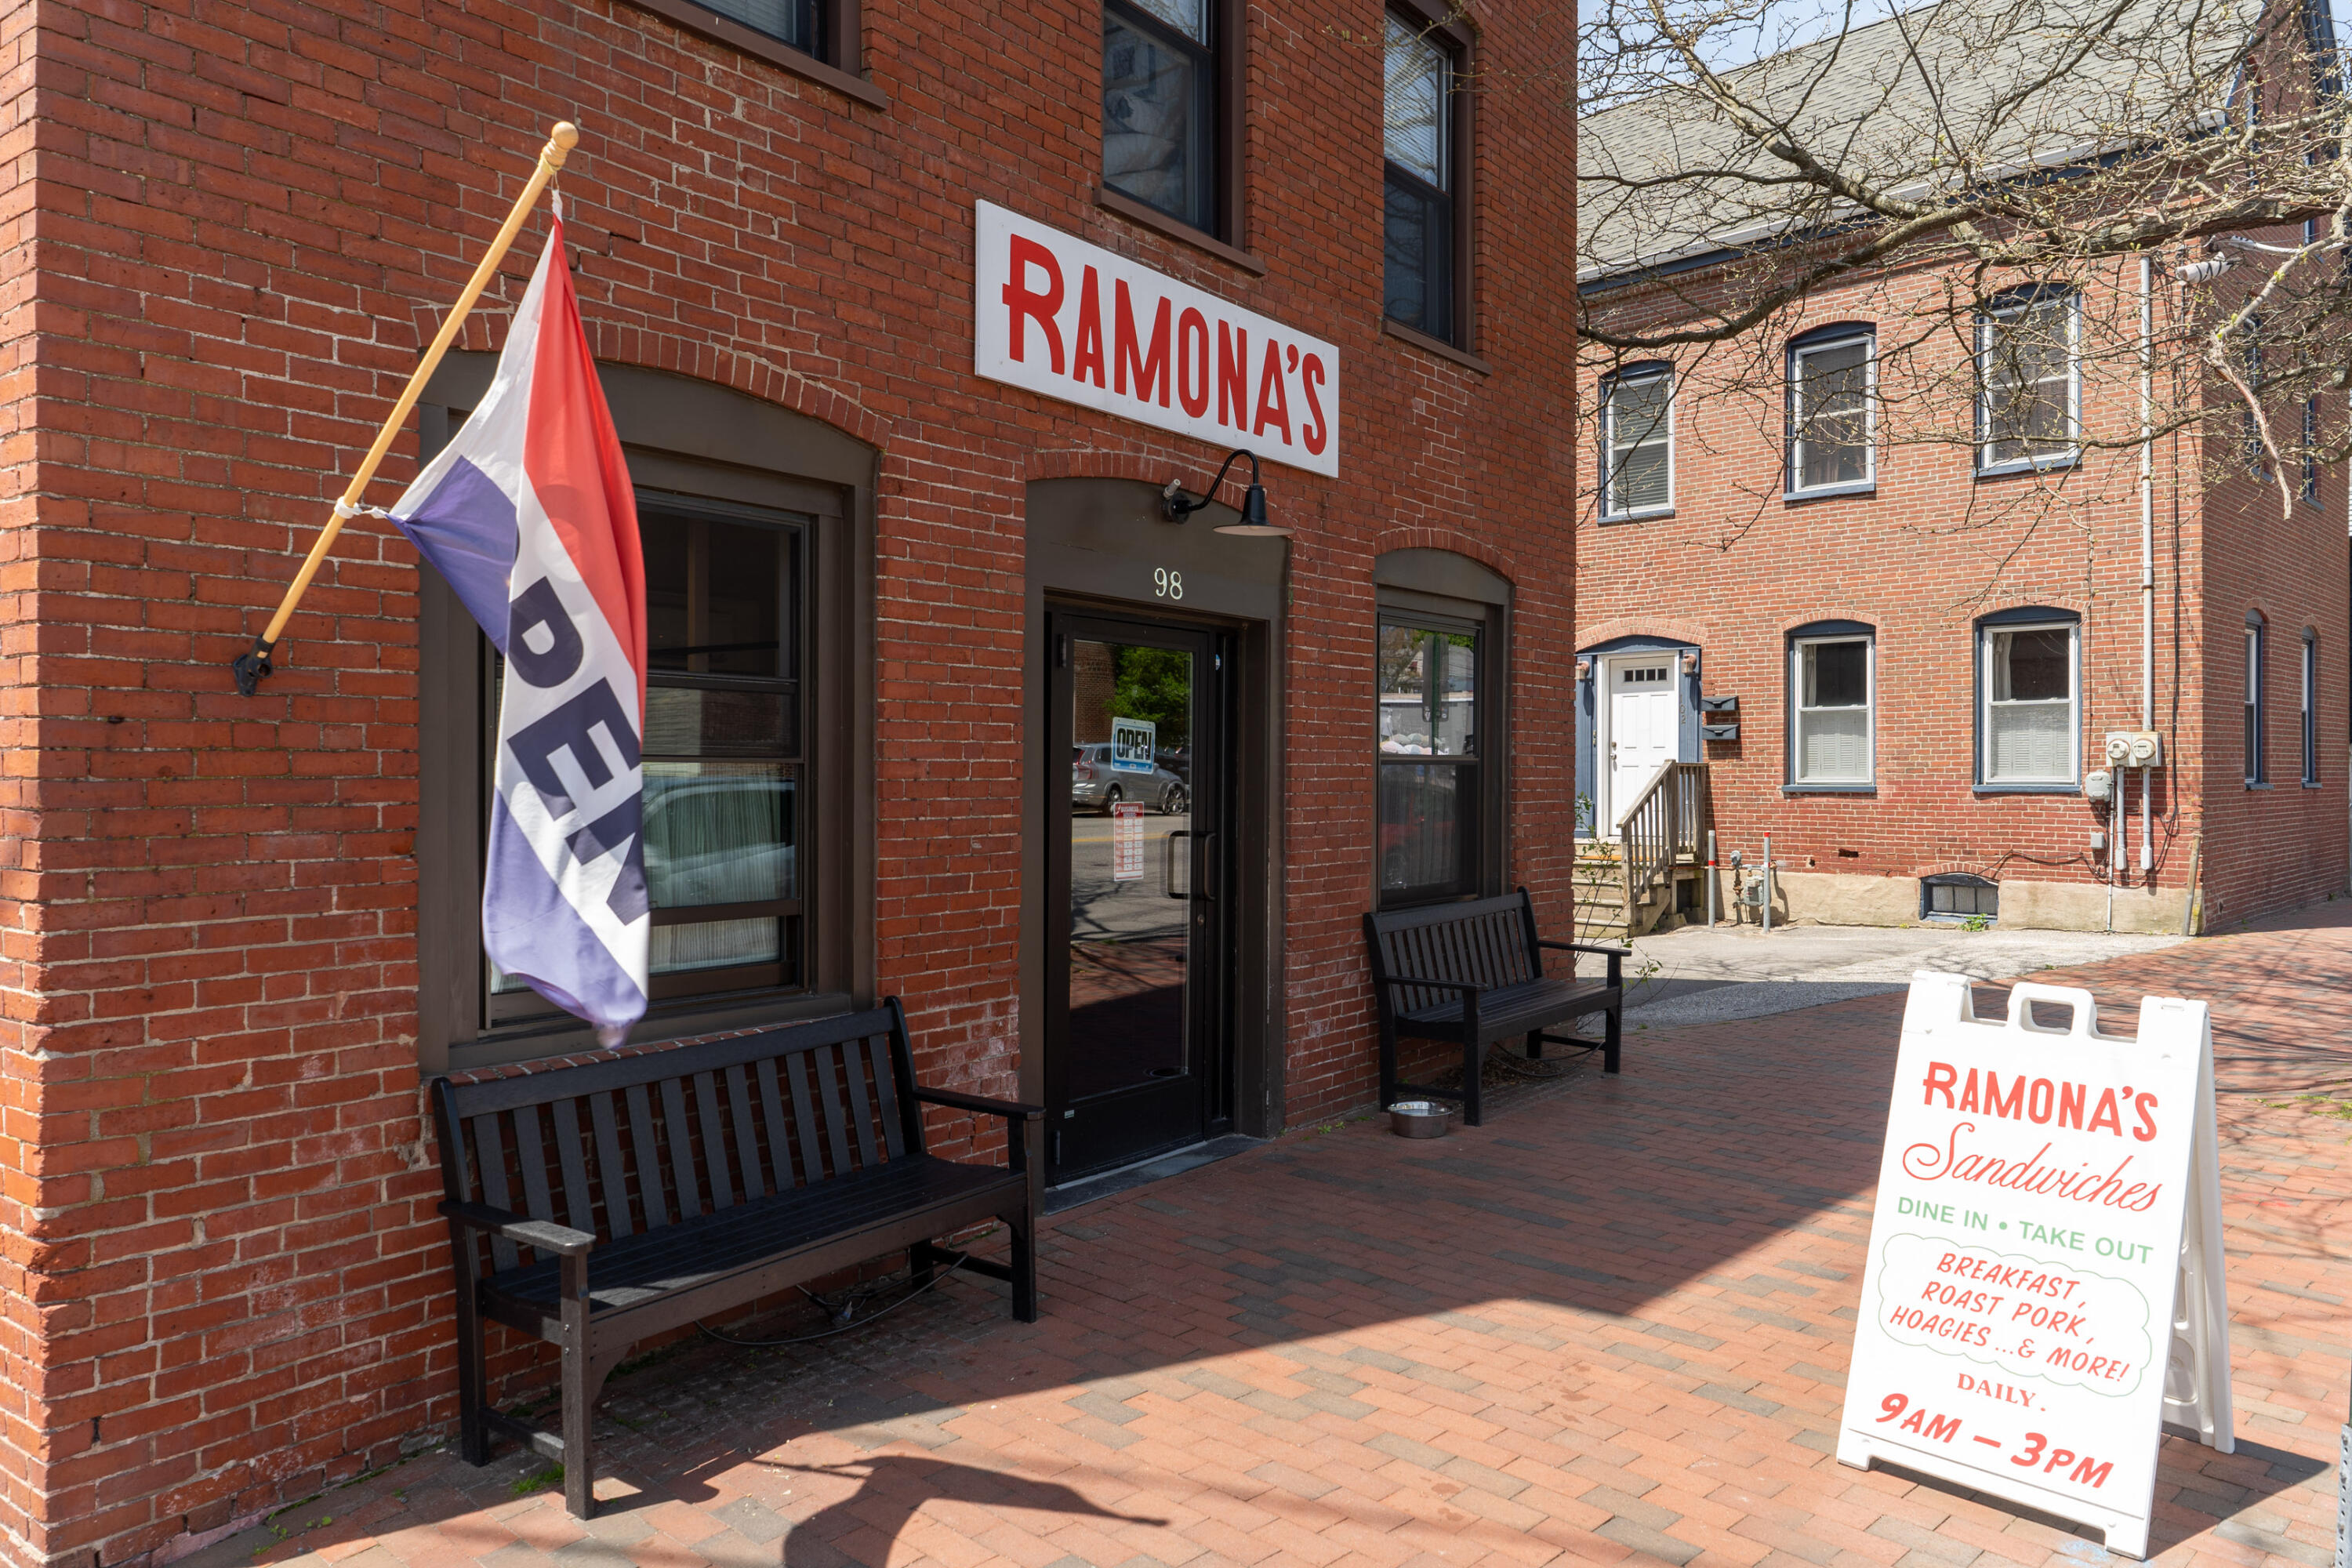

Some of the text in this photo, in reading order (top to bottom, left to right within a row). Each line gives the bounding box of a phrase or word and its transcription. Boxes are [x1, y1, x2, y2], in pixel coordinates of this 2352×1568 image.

[1002, 233, 1327, 456] RAMONA'S
[1154, 568, 1183, 601] 98
[1116, 728, 1152, 761] OPEN
[1922, 1061, 2158, 1142] RAMONA'S
[1902, 1122, 2163, 1212] Sandwiches
[1897, 1197, 2154, 1265] DINE IN TAKE OUT
[1921, 1281, 2095, 1345] ROAST PORK,
[1936, 1252, 2087, 1309] BREAKFAST,
[2046, 1347, 2130, 1382] MORE!
[1875, 1392, 1962, 1443] 9AM
[2010, 1432, 2115, 1489] 3PM
